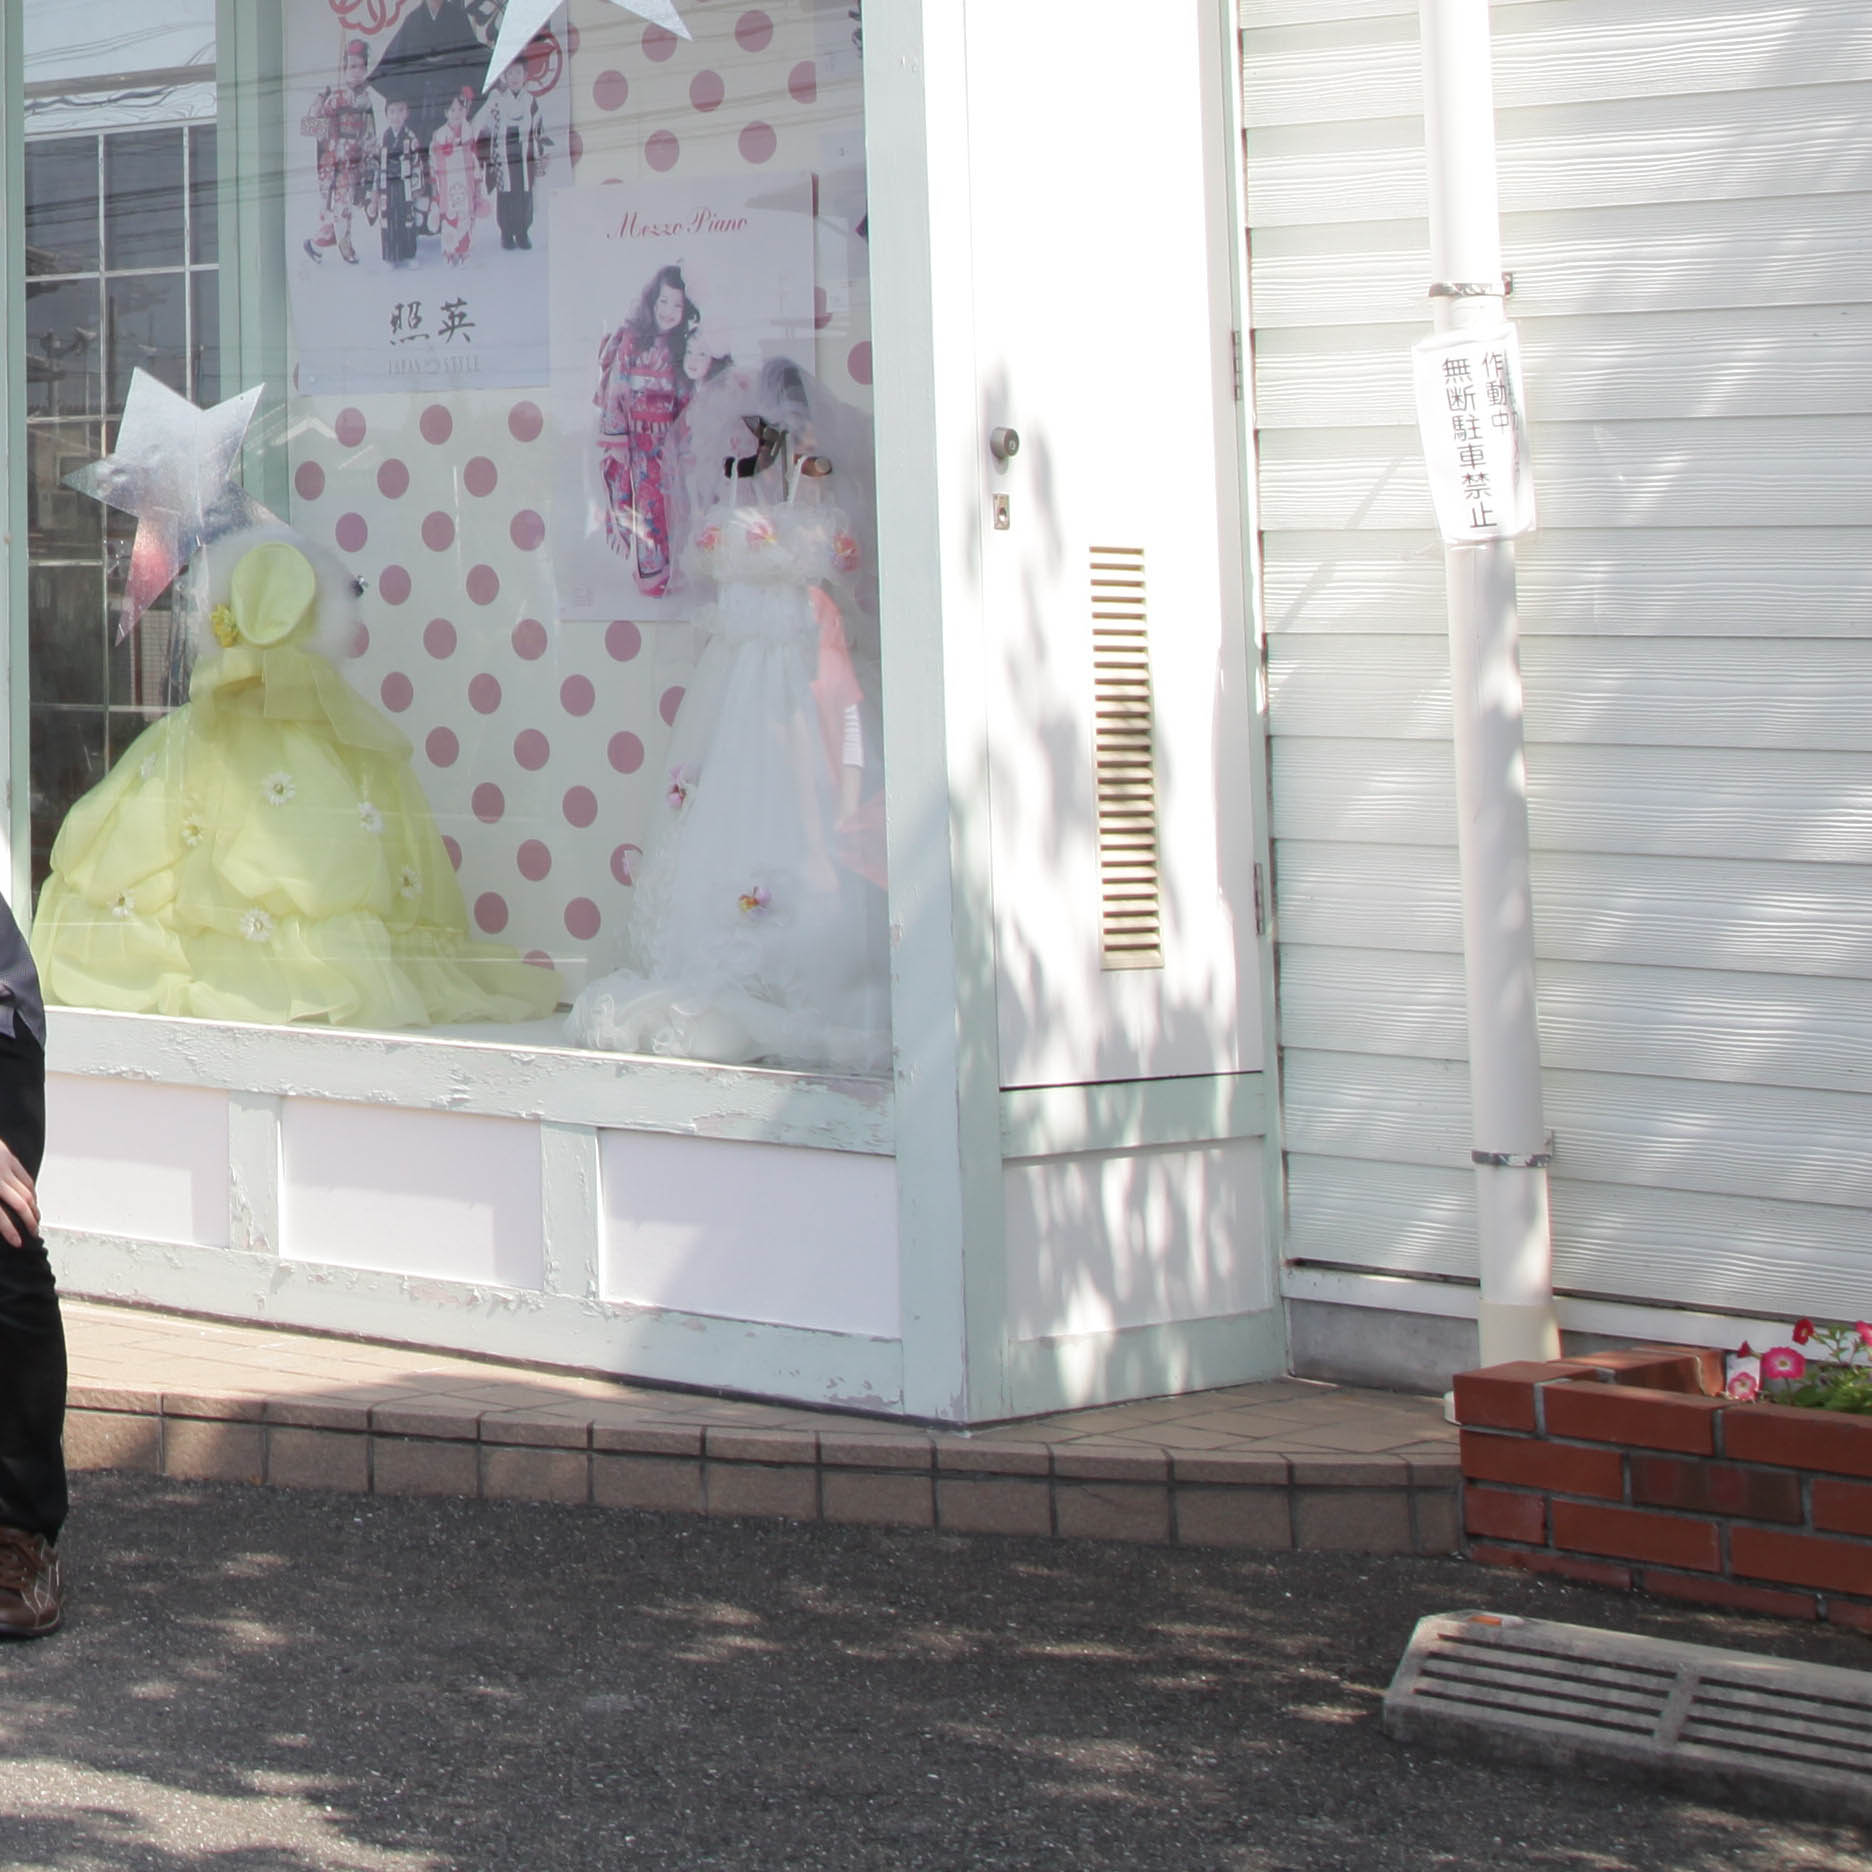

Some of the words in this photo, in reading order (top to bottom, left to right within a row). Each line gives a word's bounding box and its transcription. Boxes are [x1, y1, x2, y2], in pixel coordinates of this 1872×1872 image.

[606, 209, 683, 240] Mezzo
[686, 206, 748, 234] Piano
[389, 297, 476, 346] 照英
[1482, 351, 1508, 434] 作動中
[1442, 357, 1498, 529] 無断駐車禁止
